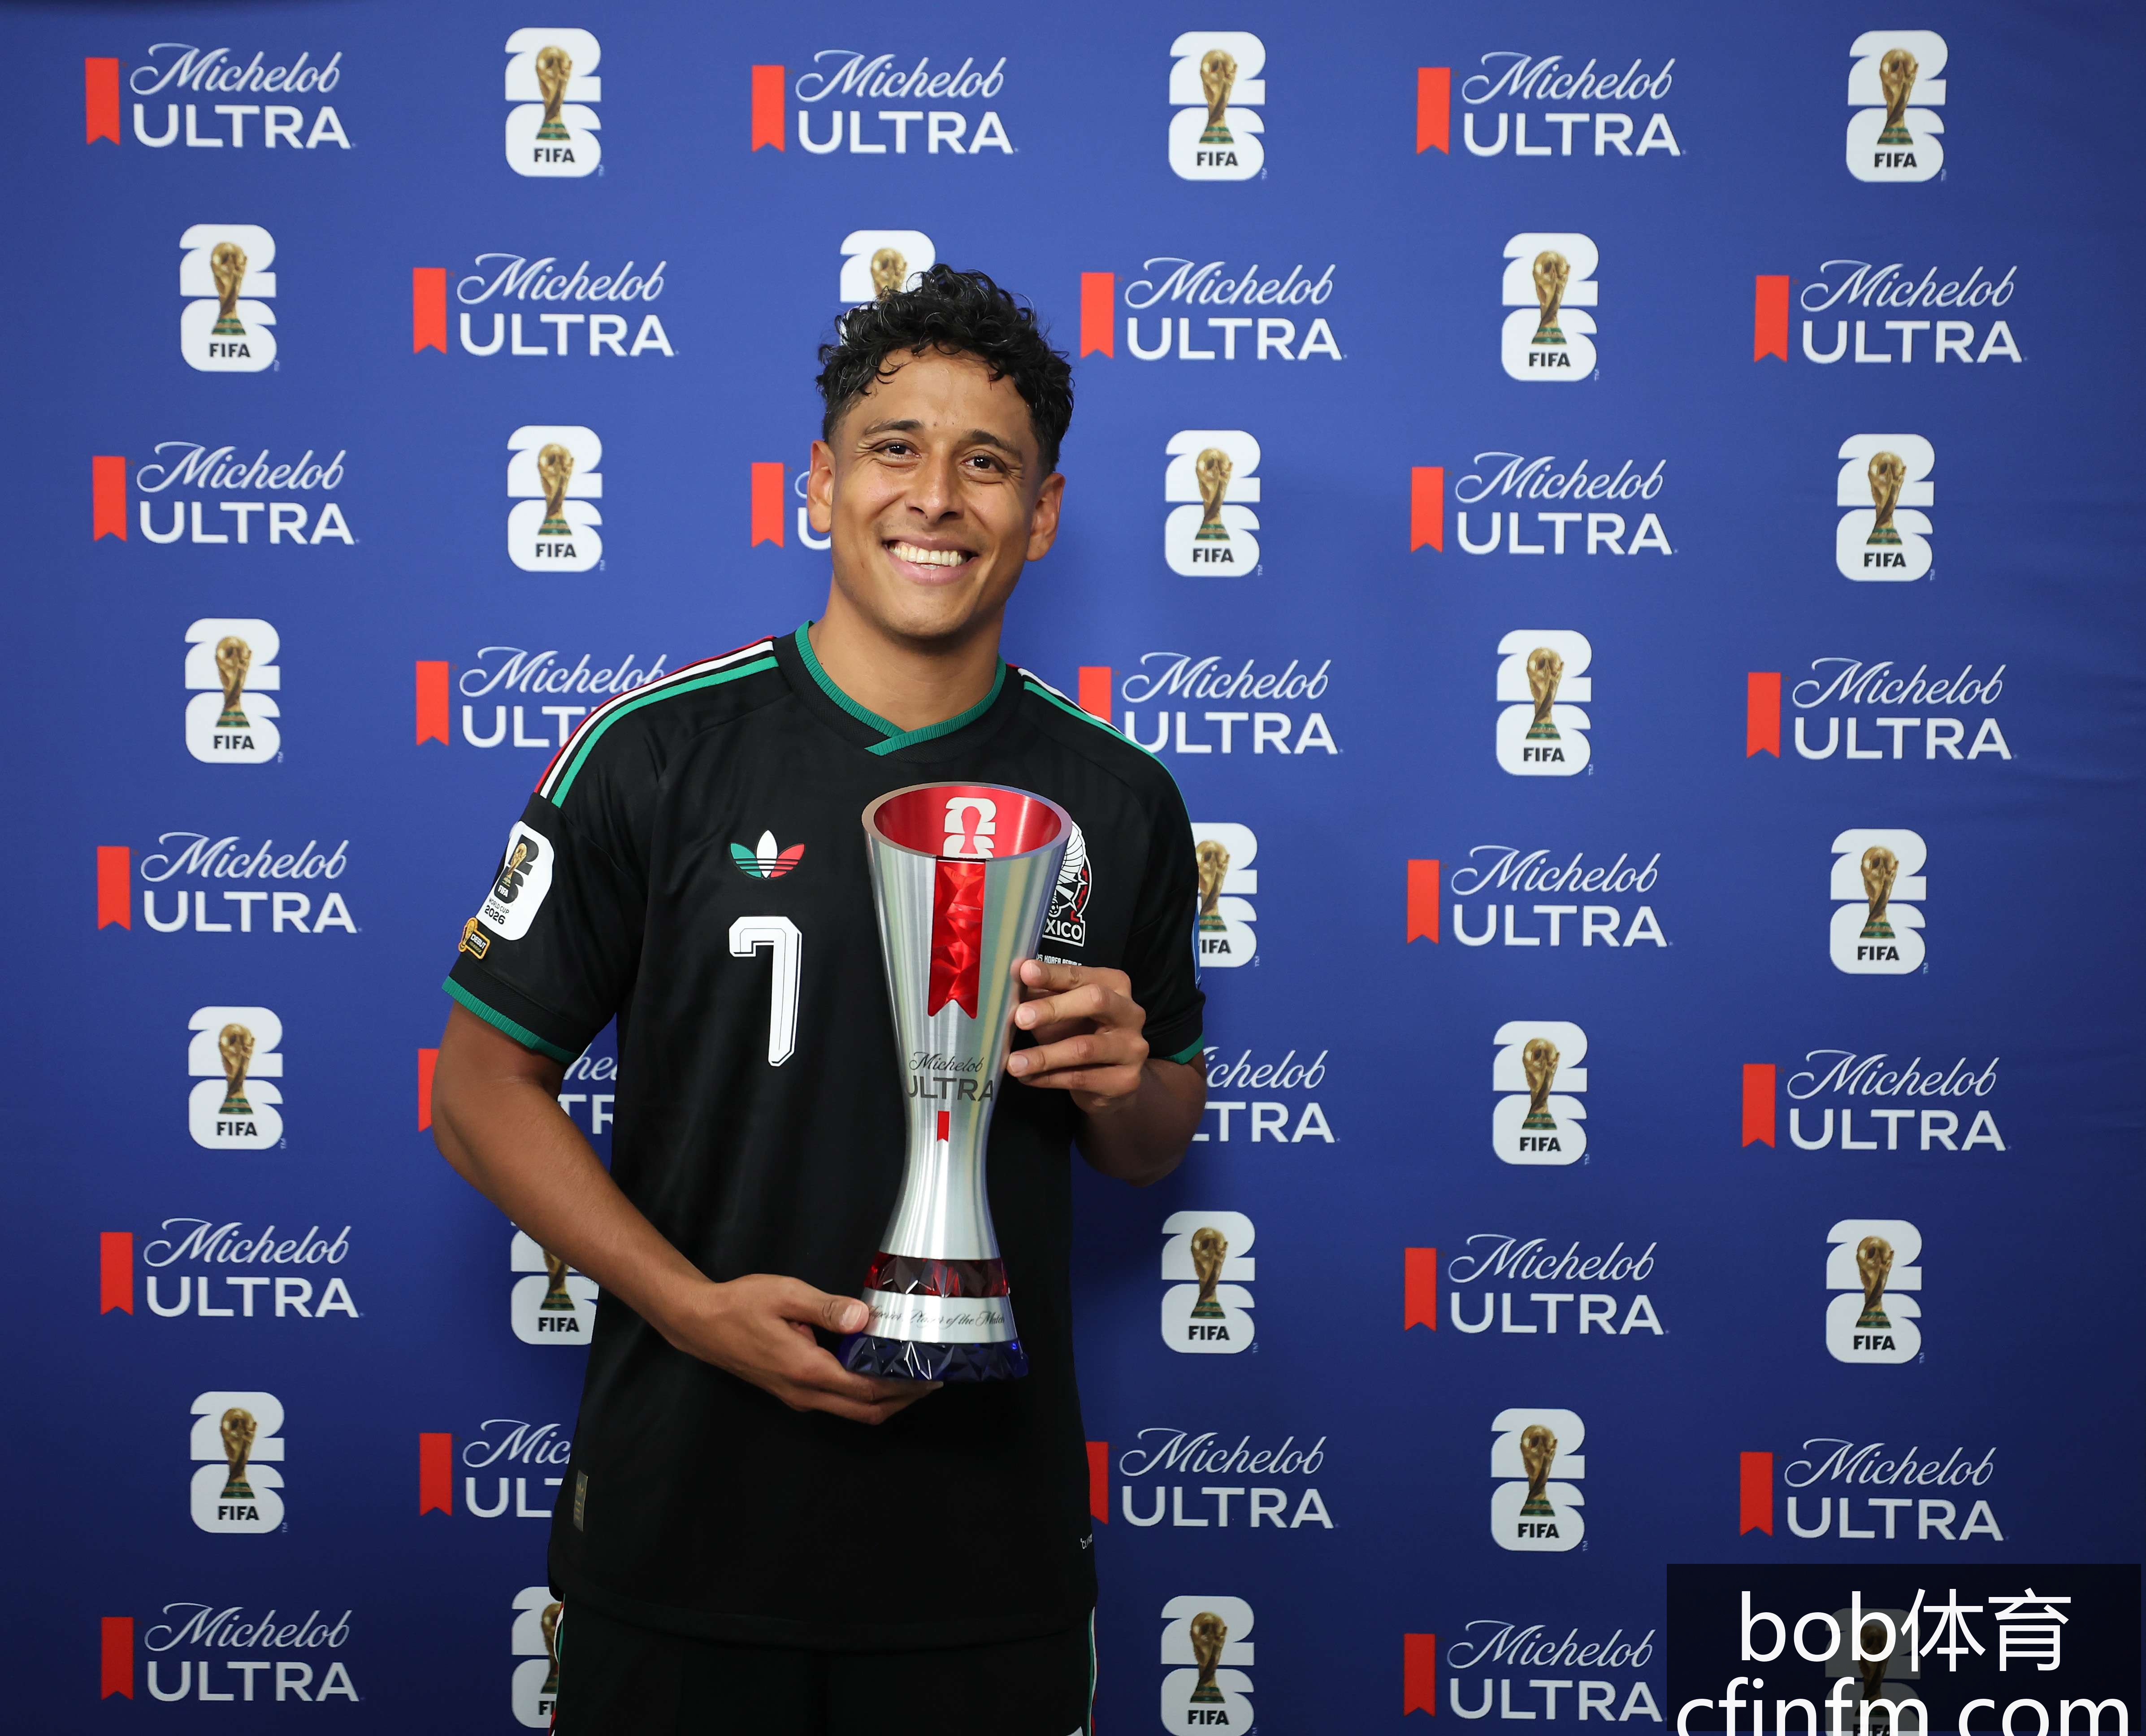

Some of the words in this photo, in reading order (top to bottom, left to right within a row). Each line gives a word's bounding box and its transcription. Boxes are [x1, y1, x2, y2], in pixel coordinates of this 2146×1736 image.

[130, 43, 342, 95] Michelob
[795, 50, 1007, 102] Michelob
[1462, 52, 1676, 104] Michelob
[133, 103, 351, 149] ULTRA
[798, 110, 1014, 155] ULTRA
[1464, 112, 1681, 157] ULTRA
[534, 148, 575, 163] FIFA
[1197, 152, 1238, 166] FIFA
[1874, 153, 1917, 168] FIFA
[456, 253, 667, 304] Michelob
[1124, 257, 1336, 309] Michelob
[1800, 260, 2017, 312] Michelob
[210, 343, 251, 358] FIFA
[460, 312, 675, 357] ULTRA
[1127, 317, 1342, 361] ULTRA
[1802, 320, 2022, 364] ULTRA
[1529, 352, 1570, 367] FIFA
[136, 441, 346, 493] Michelob
[1455, 451, 1666, 503] Michelob
[139, 500, 355, 545] ULTRA
[1457, 511, 1673, 556] ULTRA
[536, 543, 577, 557] FIFA
[1193, 548, 1234, 563] FIFA
[1864, 553, 1906, 567] FIFA
[1122, 652, 1331, 703] Michelob
[1792, 657, 2006, 708] Michelob
[214, 735, 255, 750] FIFA
[462, 705, 600, 750] ULT
[1124, 711, 1338, 755] ULTRA
[1795, 717, 2012, 760] ULTRA
[1523, 747, 1565, 762] FIFA
[140, 832, 349, 882] Michelob
[1451, 845, 1661, 896] Michelob
[143, 890, 357, 933] ULTRA
[498, 885, 509, 898] FIFA
[500, 906, 509, 915] CUP
[484, 904, 506, 925] 2026
[1045, 918, 1082, 941] XICO
[1453, 903, 1668, 947] ULTRA
[470, 933, 486, 949] DEBUT
[1199, 939, 1231, 954] IFA
[1857, 946, 1900, 961] FIFA
[728, 916, 802, 1067] 7
[909, 1051, 984, 1072] Michelob
[1787, 1049, 1999, 1100] Michelob
[217, 1122, 258, 1136] FIFA
[1192, 1101, 1335, 1143] TRA
[1790, 1108, 2006, 1151] ULTRA
[1520, 1137, 1561, 1152] FIFA
[143, 1218, 351, 1267] Michelob
[1450, 1234, 1657, 1283] Michelob
[147, 1276, 359, 1318] ULTRA
[1451, 1292, 1664, 1335] ULTRA
[538, 1317, 580, 1332] FIFA
[1188, 1325, 1230, 1341] FIFA
[1854, 1335, 1896, 1350] FIFA
[1119, 1428, 1327, 1476] Michelob
[1784, 1438, 1997, 1488] Michelob
[218, 1506, 260, 1521] FIFA
[1122, 1485, 1334, 1529] ULTRA
[1787, 1496, 2004, 1541] ULTRA
[1518, 1523, 1560, 1538] FIFA
[145, 1602, 352, 1651] Michelob
[1448, 1620, 1656, 1669] Michelob
[147, 1661, 359, 1701] ULTRA
[1450, 1678, 1663, 1722] ULTRA
[1188, 1710, 1229, 1725] FIFA
